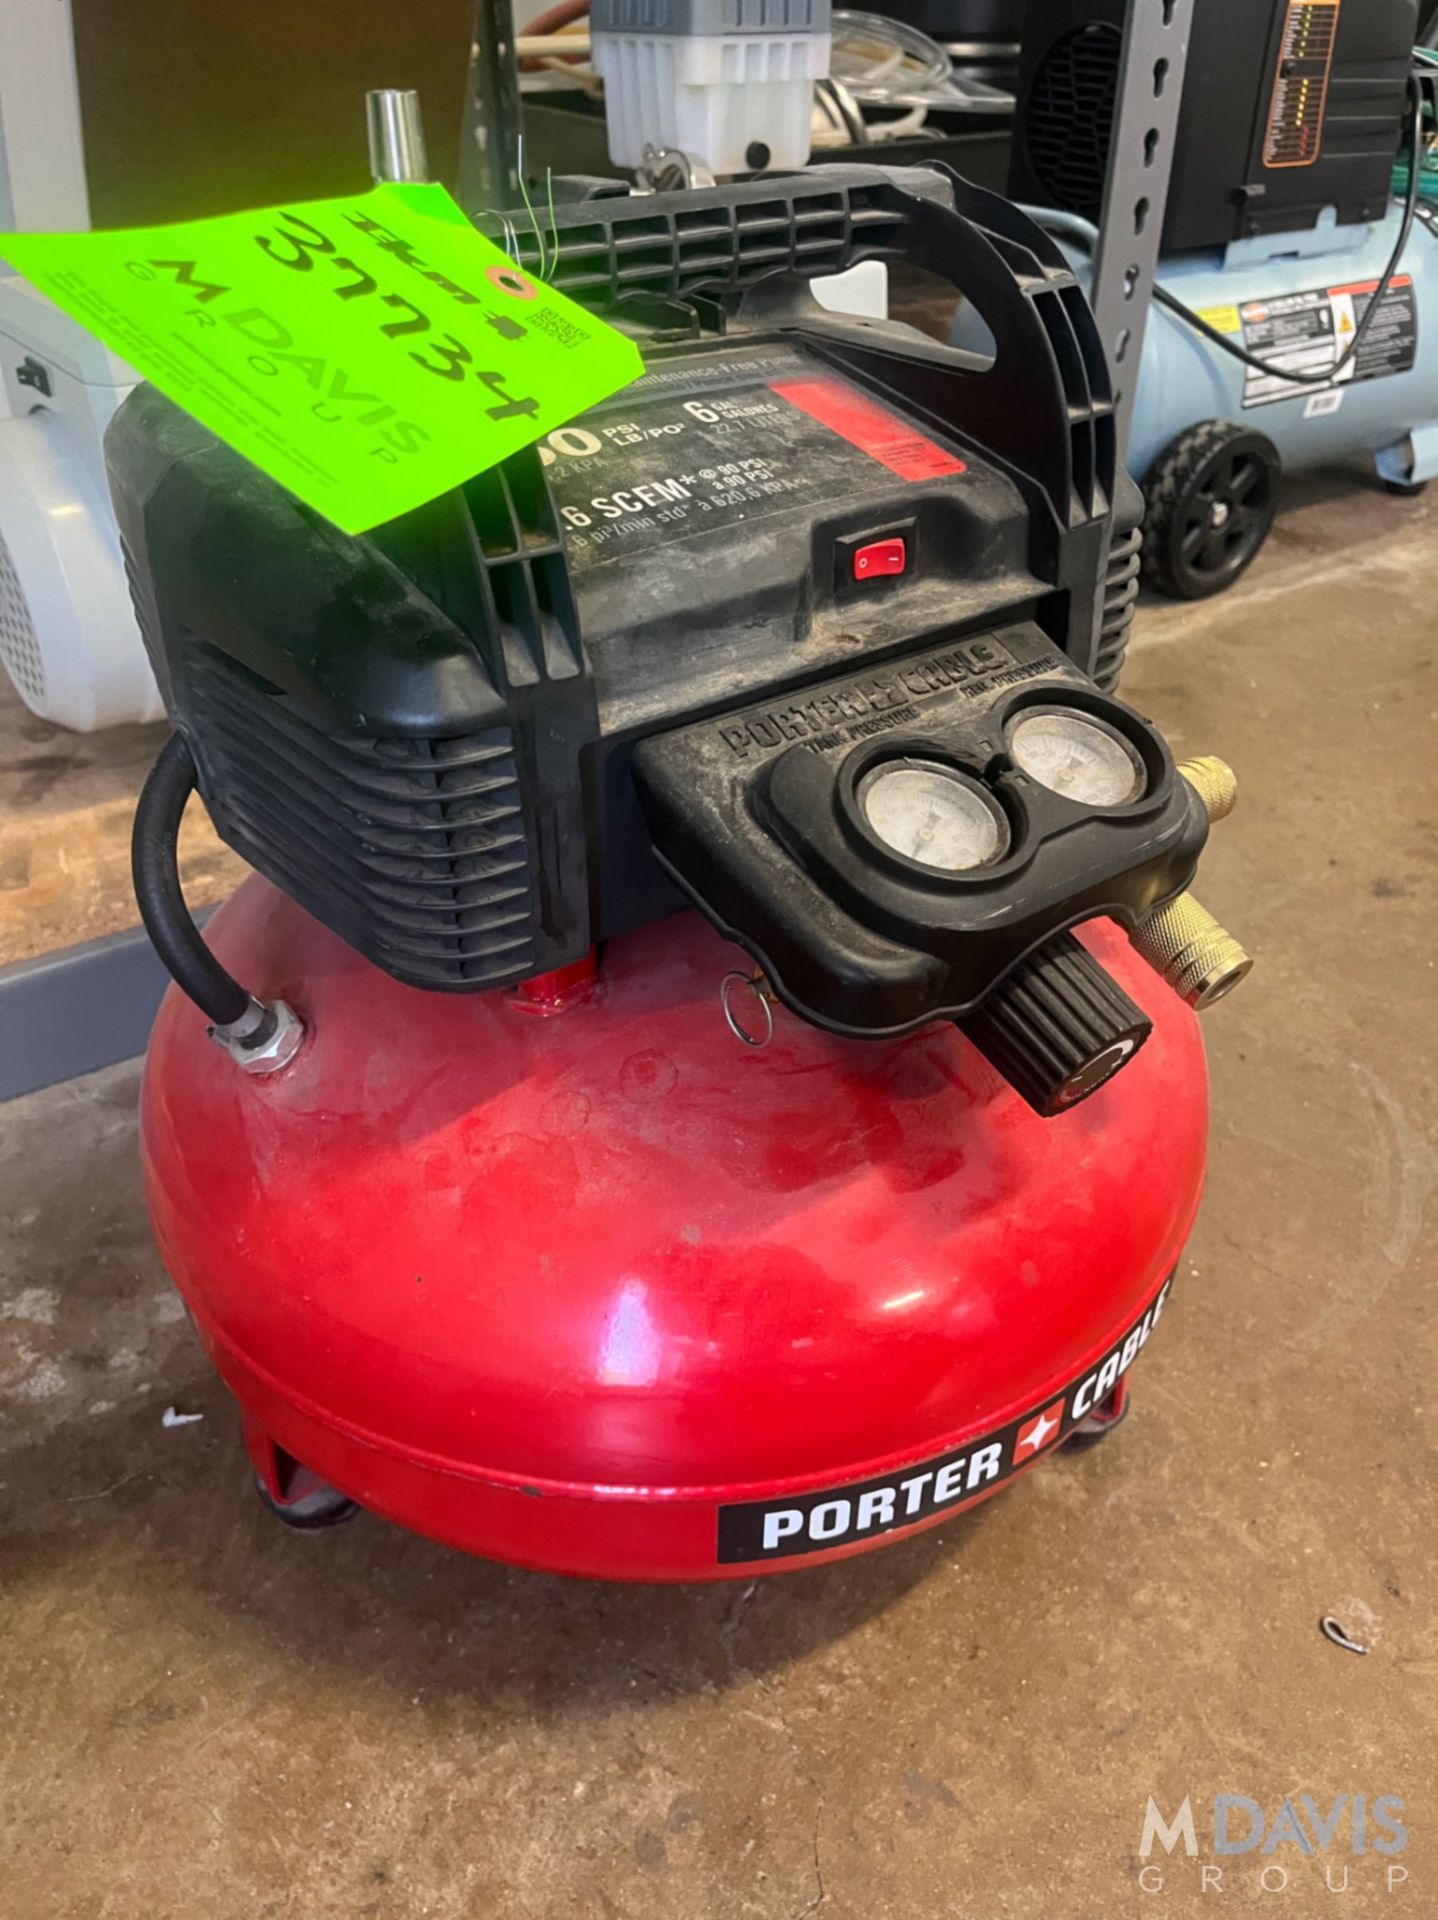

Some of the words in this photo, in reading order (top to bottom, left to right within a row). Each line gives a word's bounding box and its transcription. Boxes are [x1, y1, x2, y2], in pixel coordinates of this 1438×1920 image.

[254, 211, 541, 421] 37734
[124, 260, 399, 464] GROUP
[147, 259, 233, 304] M
[221, 307, 433, 455] DAVIS
[627, 362, 758, 391] aintenance-Free
[602, 422, 641, 438] PSI
[682, 401, 720, 424] 6
[710, 399, 738, 412] GAL
[698, 468, 718, 480] @
[716, 463, 741, 475] 90
[737, 457, 768, 471] PSI
[722, 474, 747, 487] 90
[743, 468, 775, 482] PSI
[718, 686, 867, 759] PORTER
[899, 642, 1005, 696] CABLE
[845, 704, 921, 742] PRESSURE
[762, 1441, 1003, 1549] PORTER
